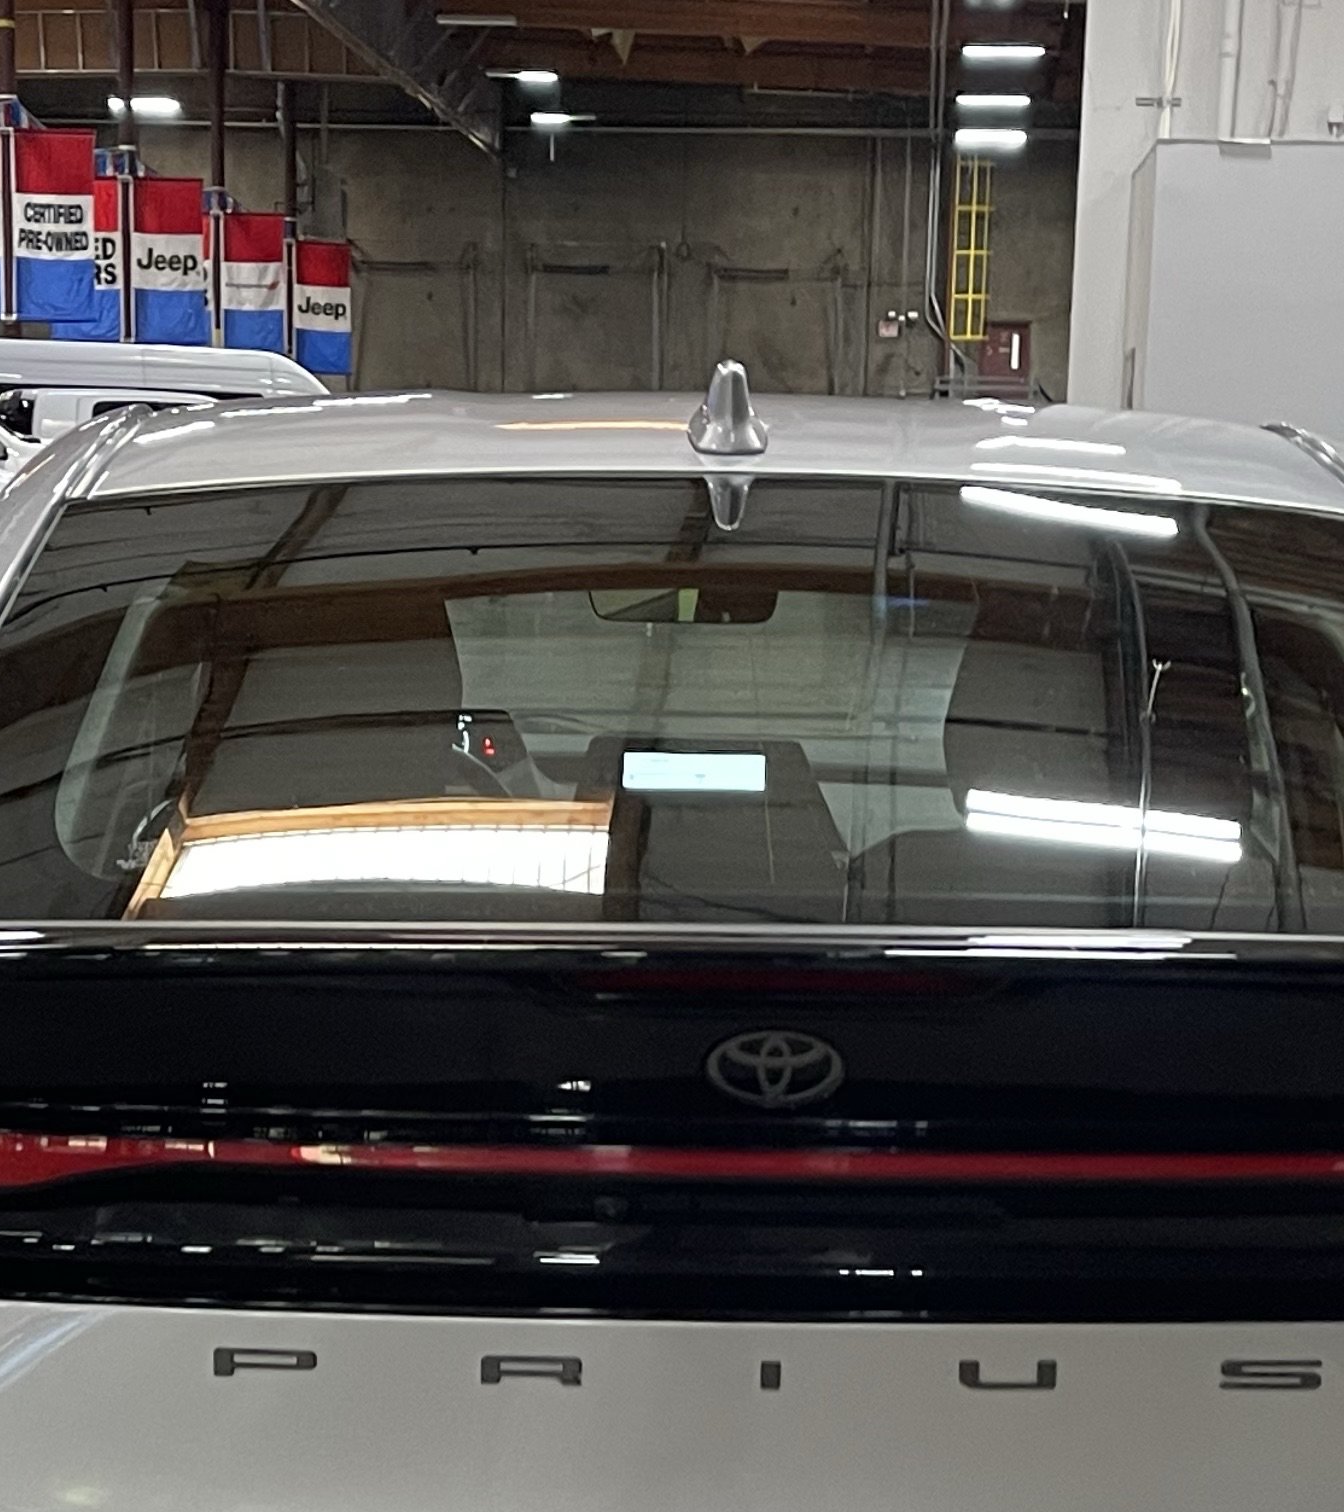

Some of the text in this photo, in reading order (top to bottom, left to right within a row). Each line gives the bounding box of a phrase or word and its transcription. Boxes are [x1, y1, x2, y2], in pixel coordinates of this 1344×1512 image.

[24, 202, 83, 224] CERTIFIED
[18, 228, 89, 251] PRE-OWNED
[137, 248, 198, 275] Jeep
[298, 296, 346, 320] Jeep
[213, 1346, 1323, 1392] PRIUS
